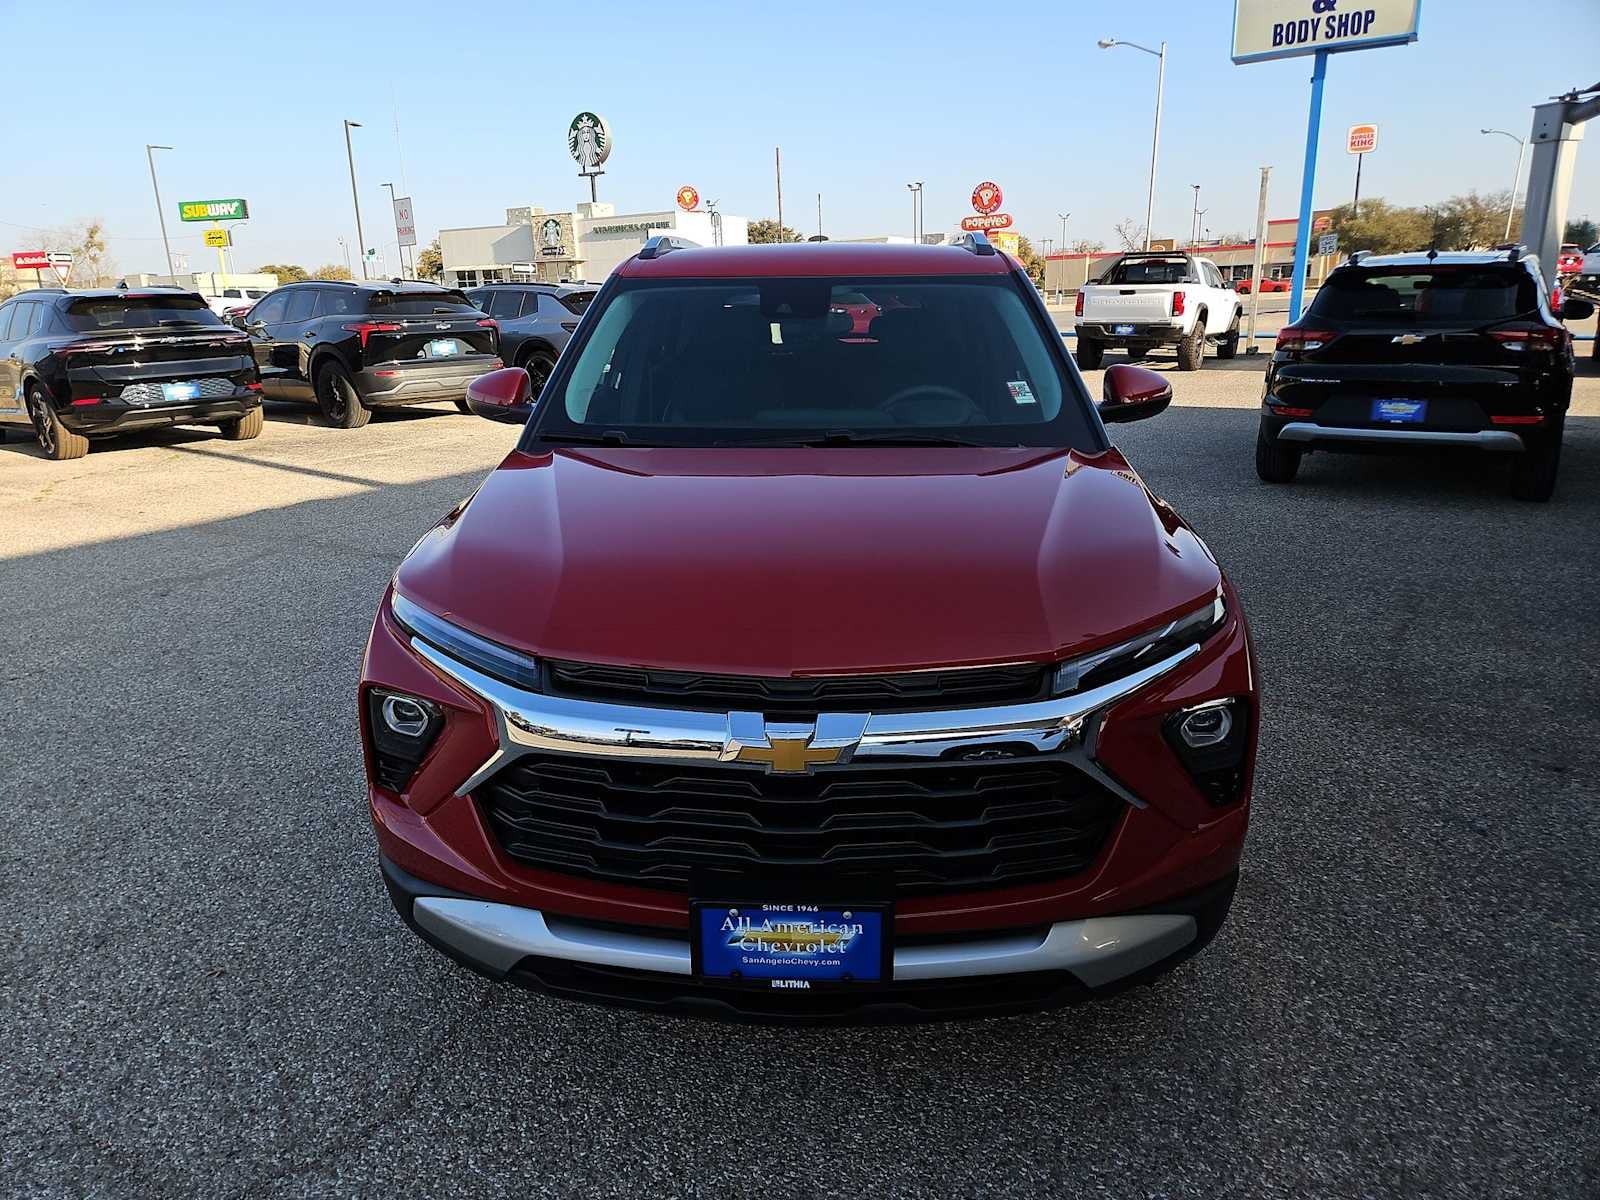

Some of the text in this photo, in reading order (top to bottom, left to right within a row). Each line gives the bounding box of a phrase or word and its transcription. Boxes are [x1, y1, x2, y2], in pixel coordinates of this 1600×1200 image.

[1272, 9, 1375, 47] BODY SHOP
[1351, 138, 1374, 147] KING
[979, 189, 994, 206] P
[183, 202, 240, 218] SUBWAY
[399, 209, 409, 221] NO
[965, 215, 1008, 228] POPEYES
[592, 223, 640, 234] STARBUCKS
[1321, 245, 1335, 254] 35
[762, 904, 793, 912] SINCE
[720, 916, 864, 935] All American
[740, 937, 846, 954] Chevrolet
[742, 956, 841, 966] SanAngeloChevy.com
[779, 980, 810, 989] LITHIA
